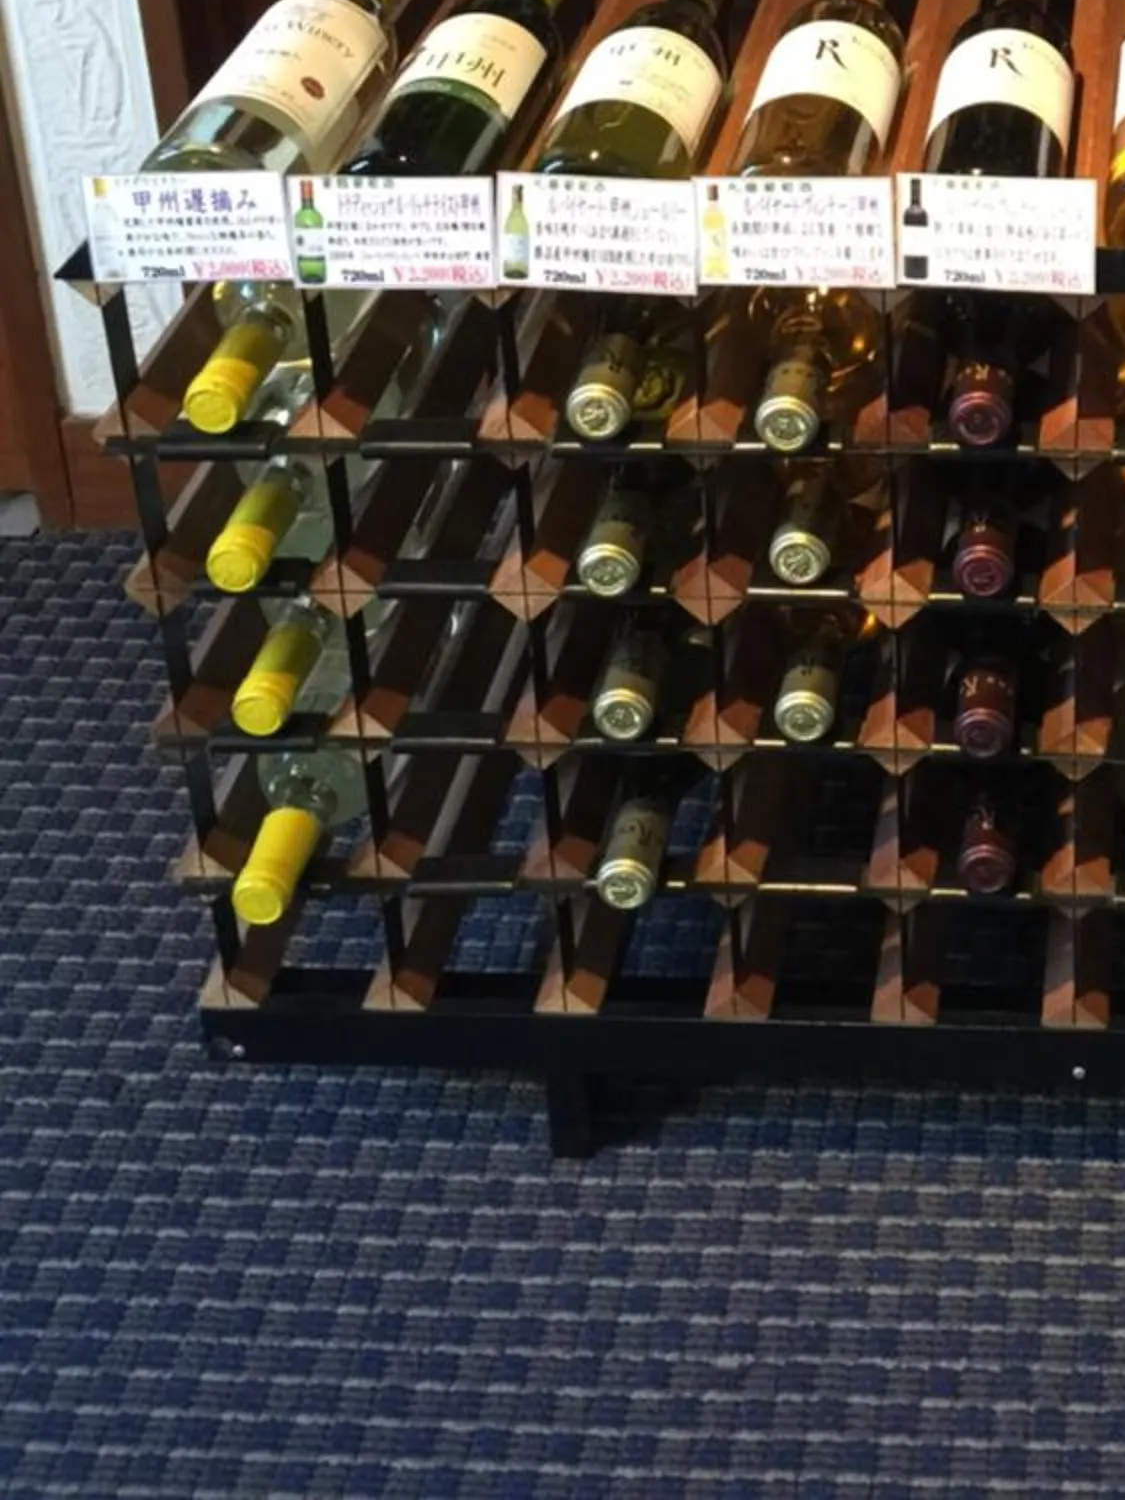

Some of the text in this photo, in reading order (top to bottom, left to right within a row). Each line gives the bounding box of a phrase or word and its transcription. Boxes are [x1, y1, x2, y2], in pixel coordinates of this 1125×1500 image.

[816, 39, 848, 71] R
[990, 48, 1024, 77] R
[543, 269, 587, 284] 720ml
